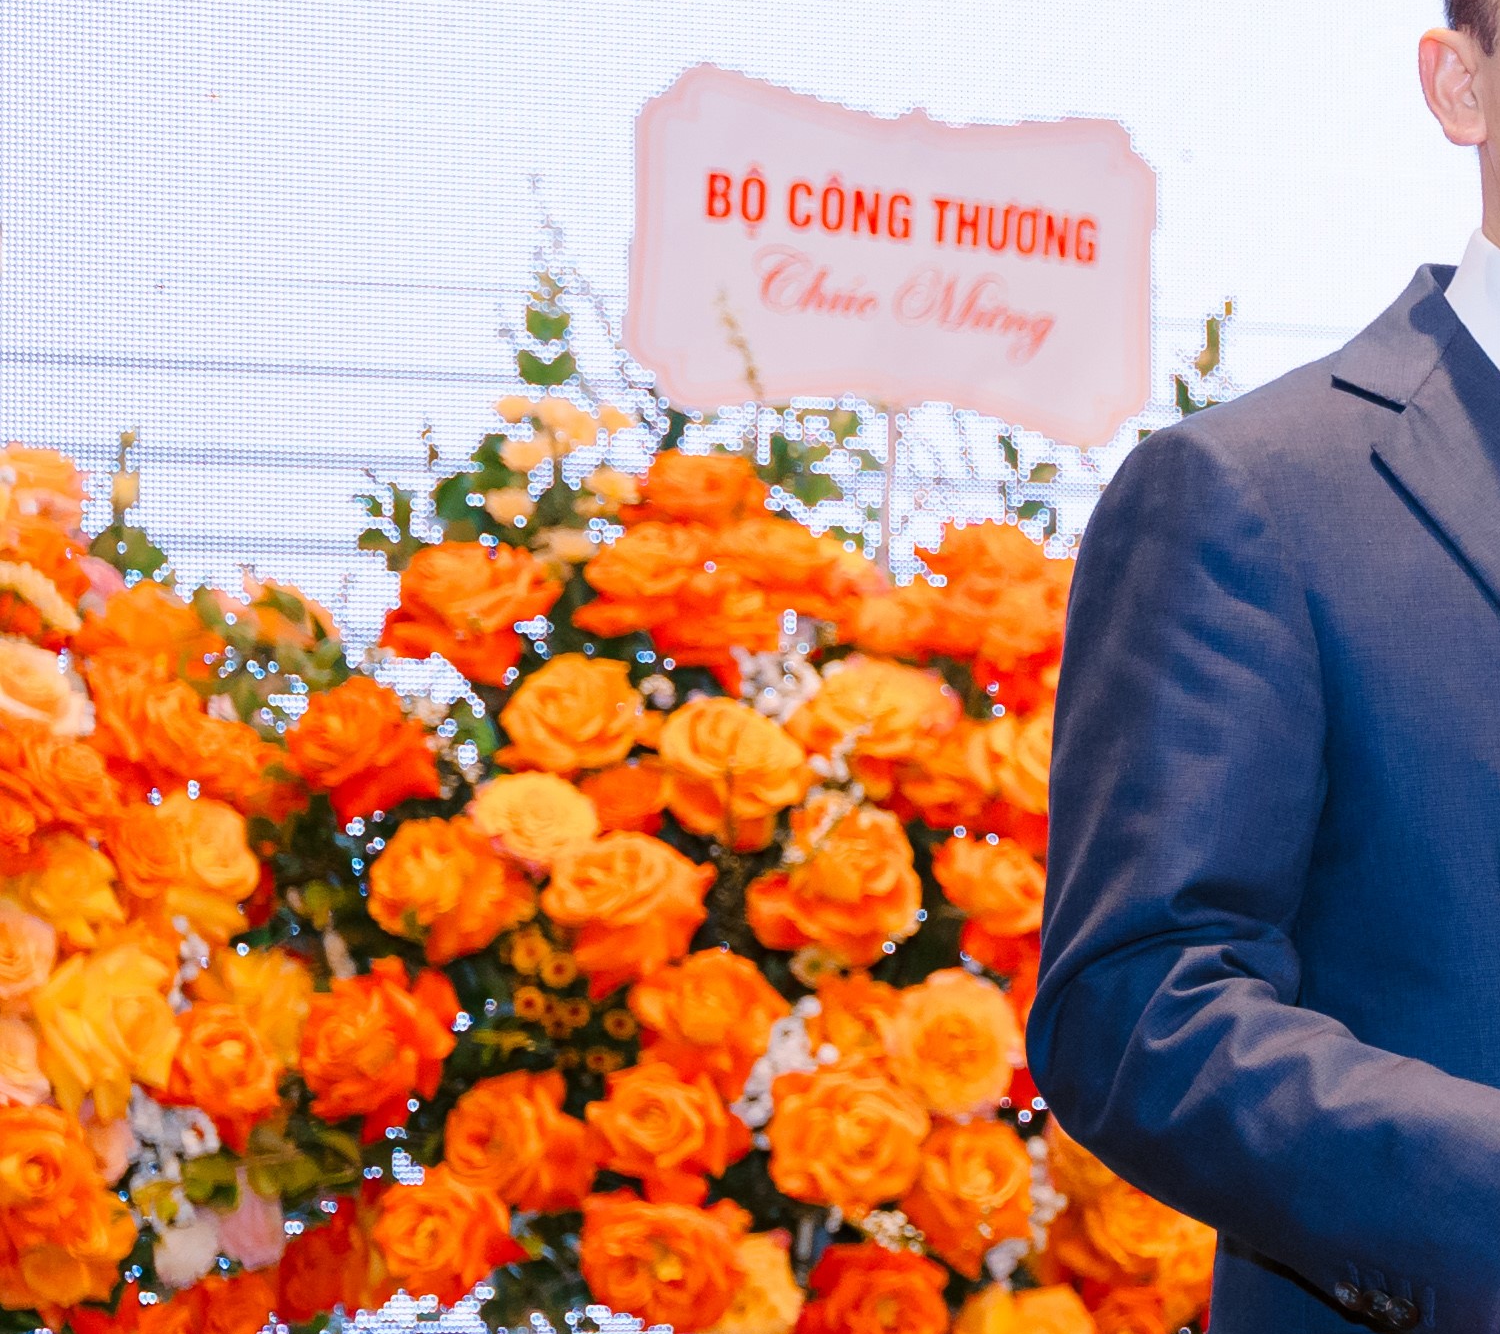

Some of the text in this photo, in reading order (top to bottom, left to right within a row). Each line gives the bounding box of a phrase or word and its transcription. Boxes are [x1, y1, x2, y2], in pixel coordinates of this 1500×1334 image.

[705, 163, 1099, 264] BỘ CÔNG THƯƠNG
